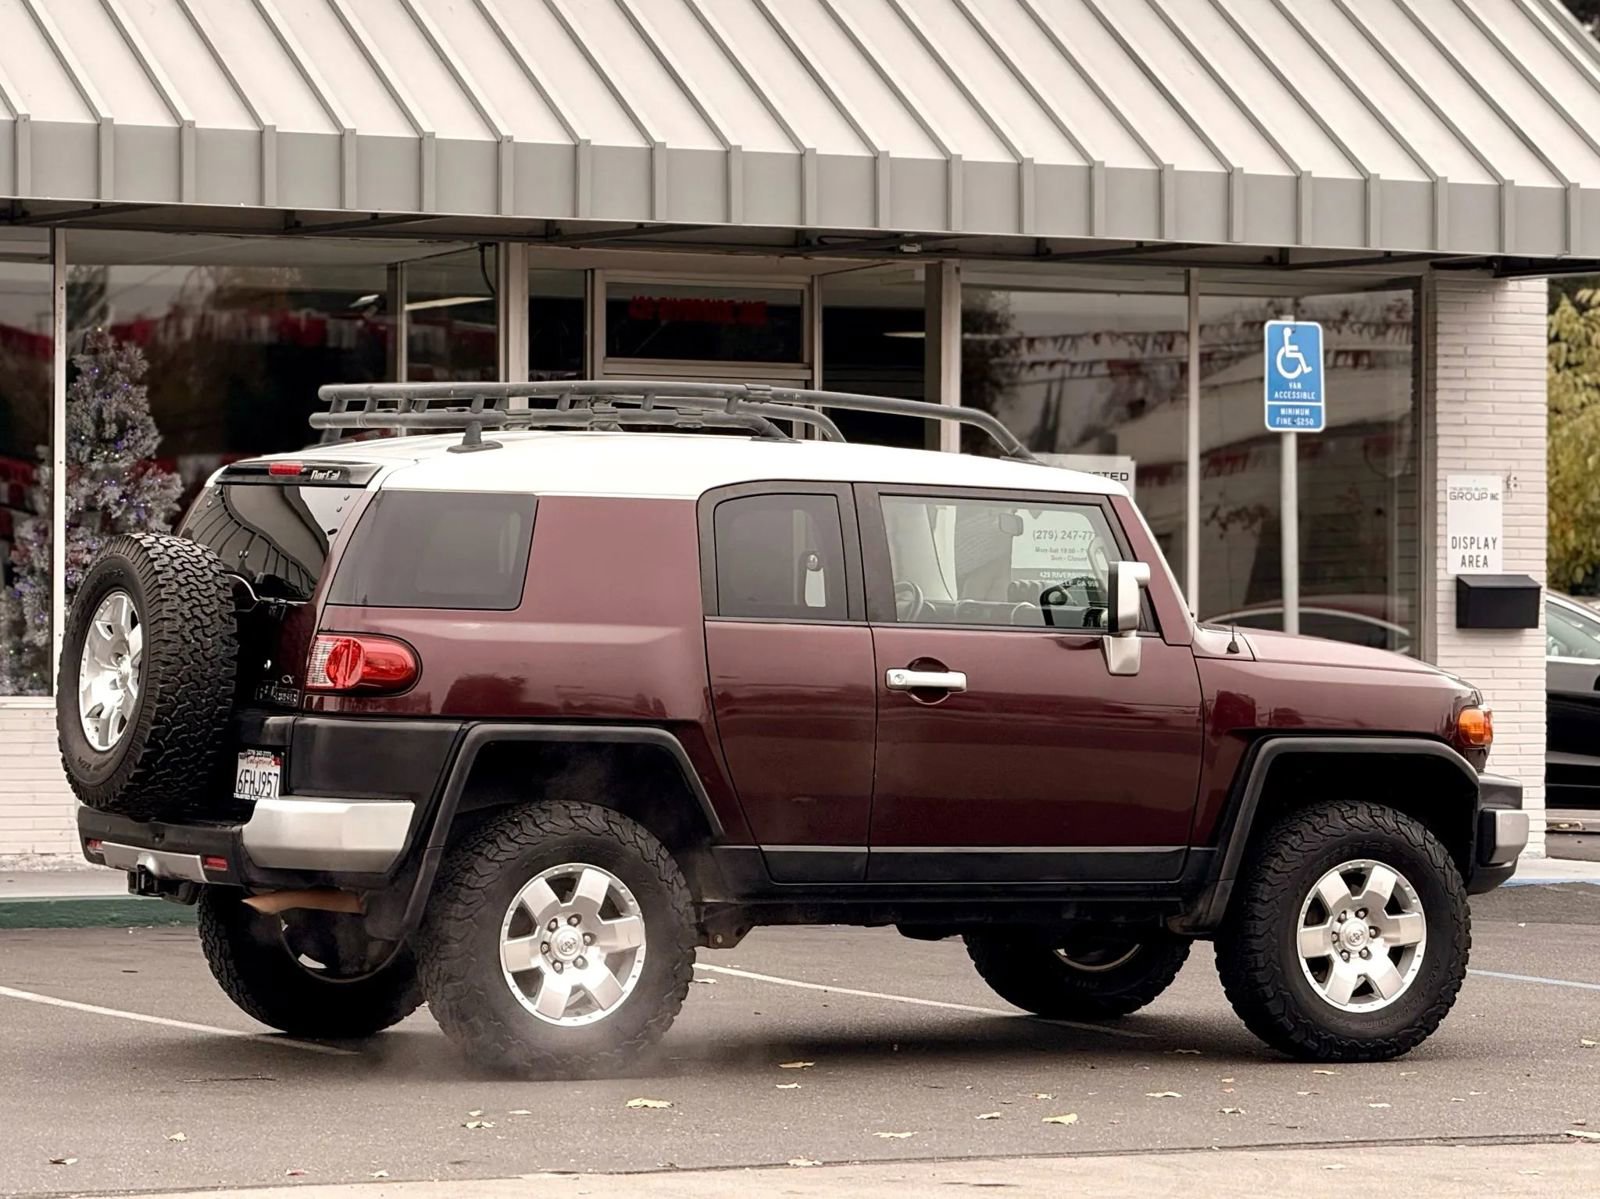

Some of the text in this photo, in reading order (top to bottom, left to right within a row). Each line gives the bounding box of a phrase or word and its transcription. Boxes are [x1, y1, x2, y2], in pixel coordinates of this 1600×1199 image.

[1288, 382, 1302, 390] VAN
[1274, 391, 1316, 400] ACCESSIBLE
[1280, 407, 1310, 416] MINIMUM
[1275, 417, 1292, 425] FINE
[1449, 491, 1488, 501] GROUP
[1033, 530, 1058, 541] (279)
[1451, 536, 1497, 550] DISPLAY
[1460, 554, 1489, 568] AREA
[237, 769, 279, 798] 6FHJ957
